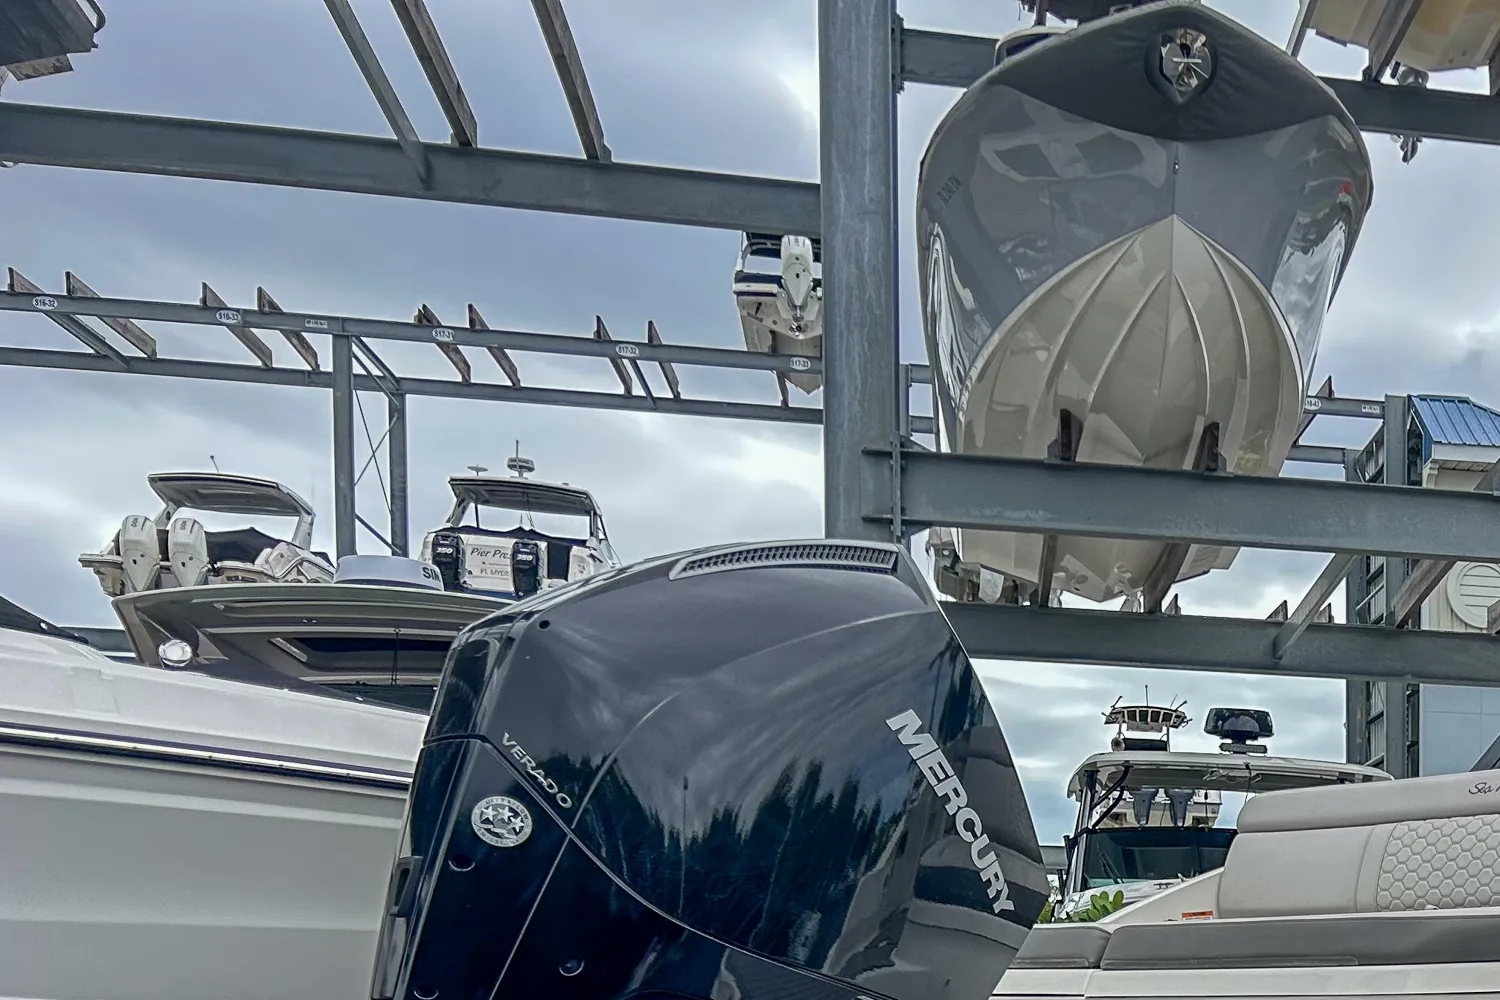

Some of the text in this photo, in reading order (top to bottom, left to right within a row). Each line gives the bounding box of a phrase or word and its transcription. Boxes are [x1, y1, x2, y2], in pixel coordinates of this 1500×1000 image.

[470, 547, 491, 557] Pier
[502, 731, 573, 809] VERADO
[1469, 781, 1494, 795] Sea
[885, 708, 1015, 914] MERCURY
